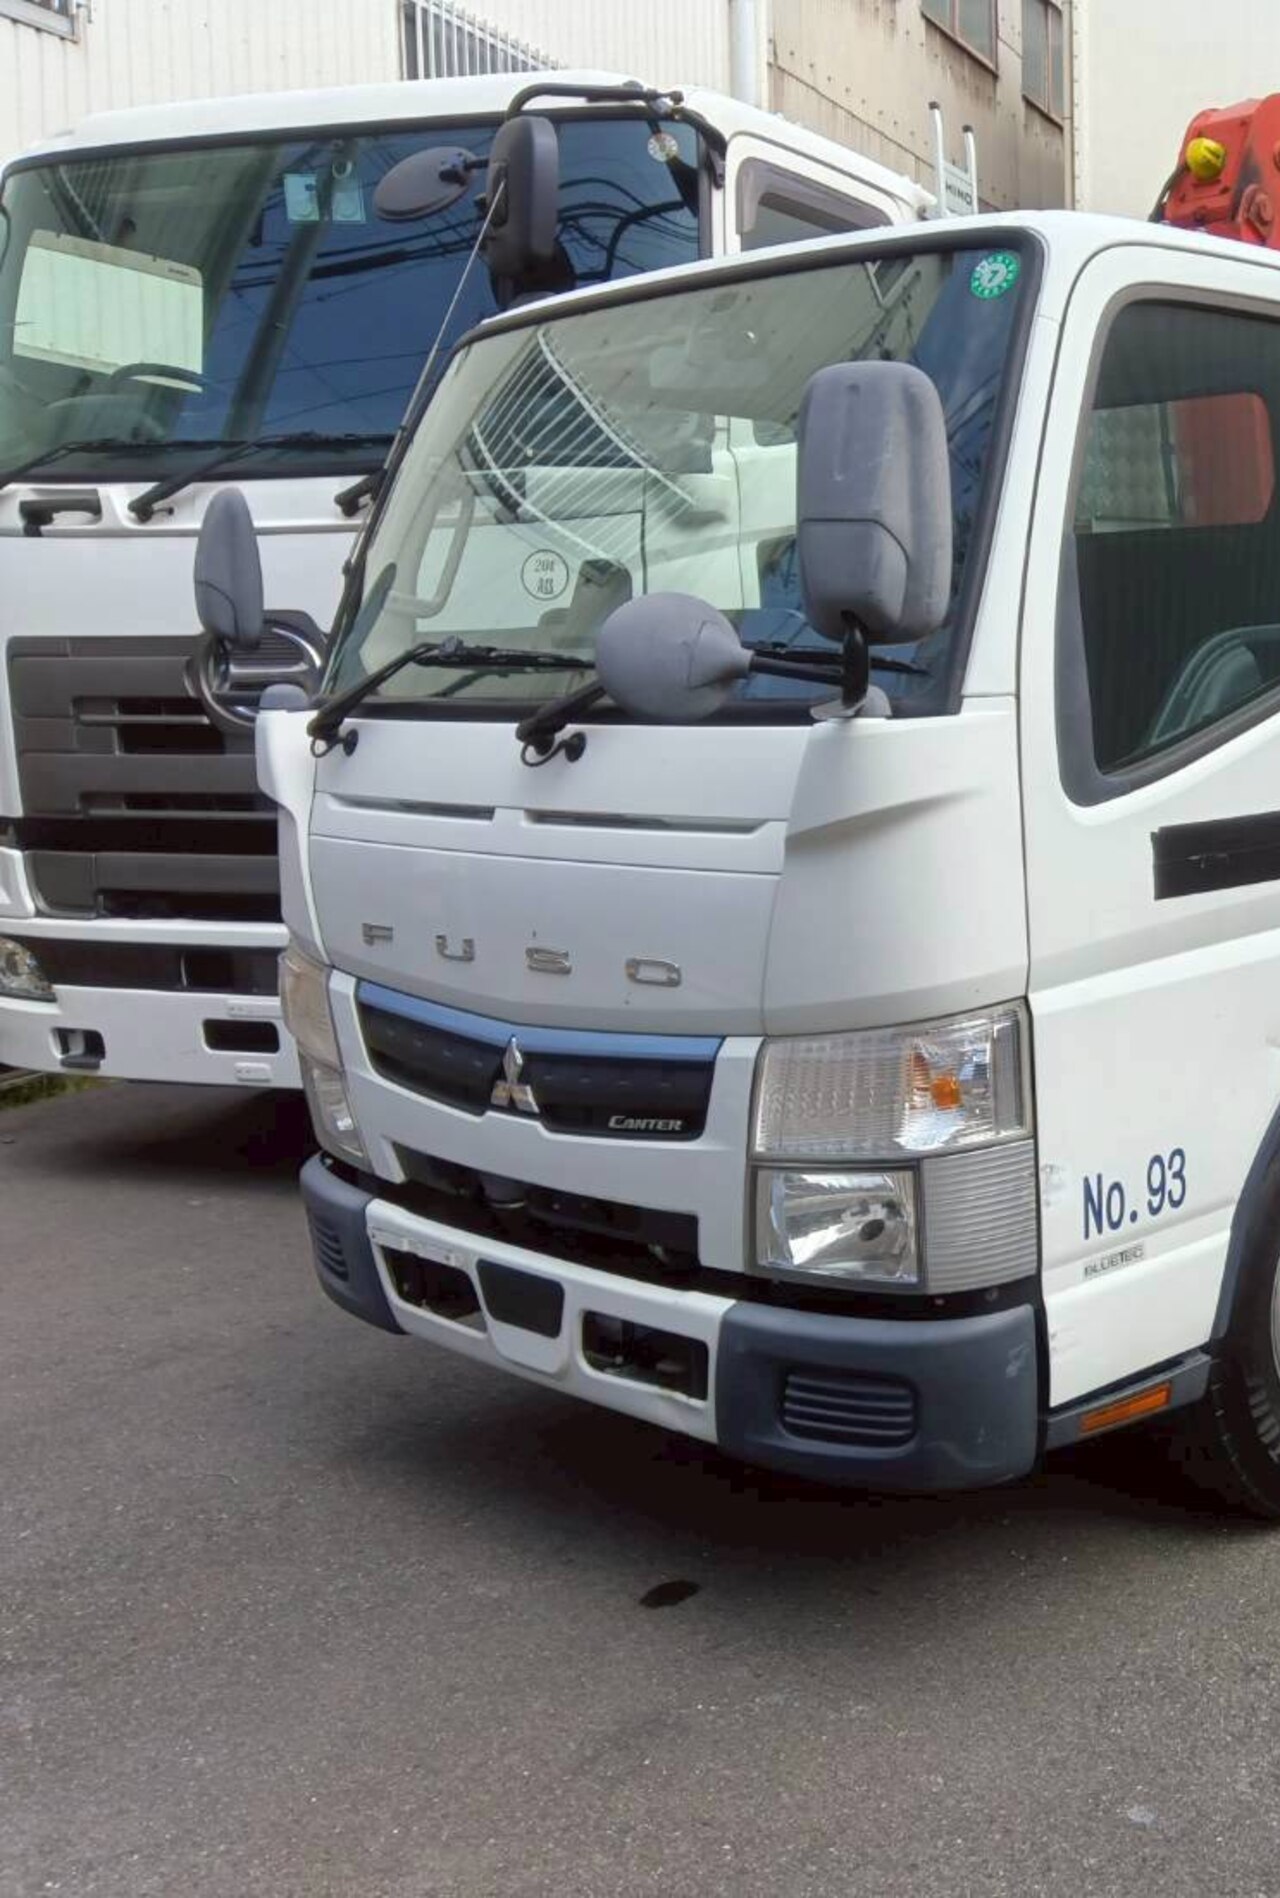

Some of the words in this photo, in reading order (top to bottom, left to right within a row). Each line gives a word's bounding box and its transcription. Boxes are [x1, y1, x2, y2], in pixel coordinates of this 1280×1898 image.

[945, 180, 973, 206] HINO
[362, 924, 682, 988] FUSO
[608, 1115, 684, 1132] CANTER
[1084, 1243, 1144, 1276] BLUETEC
